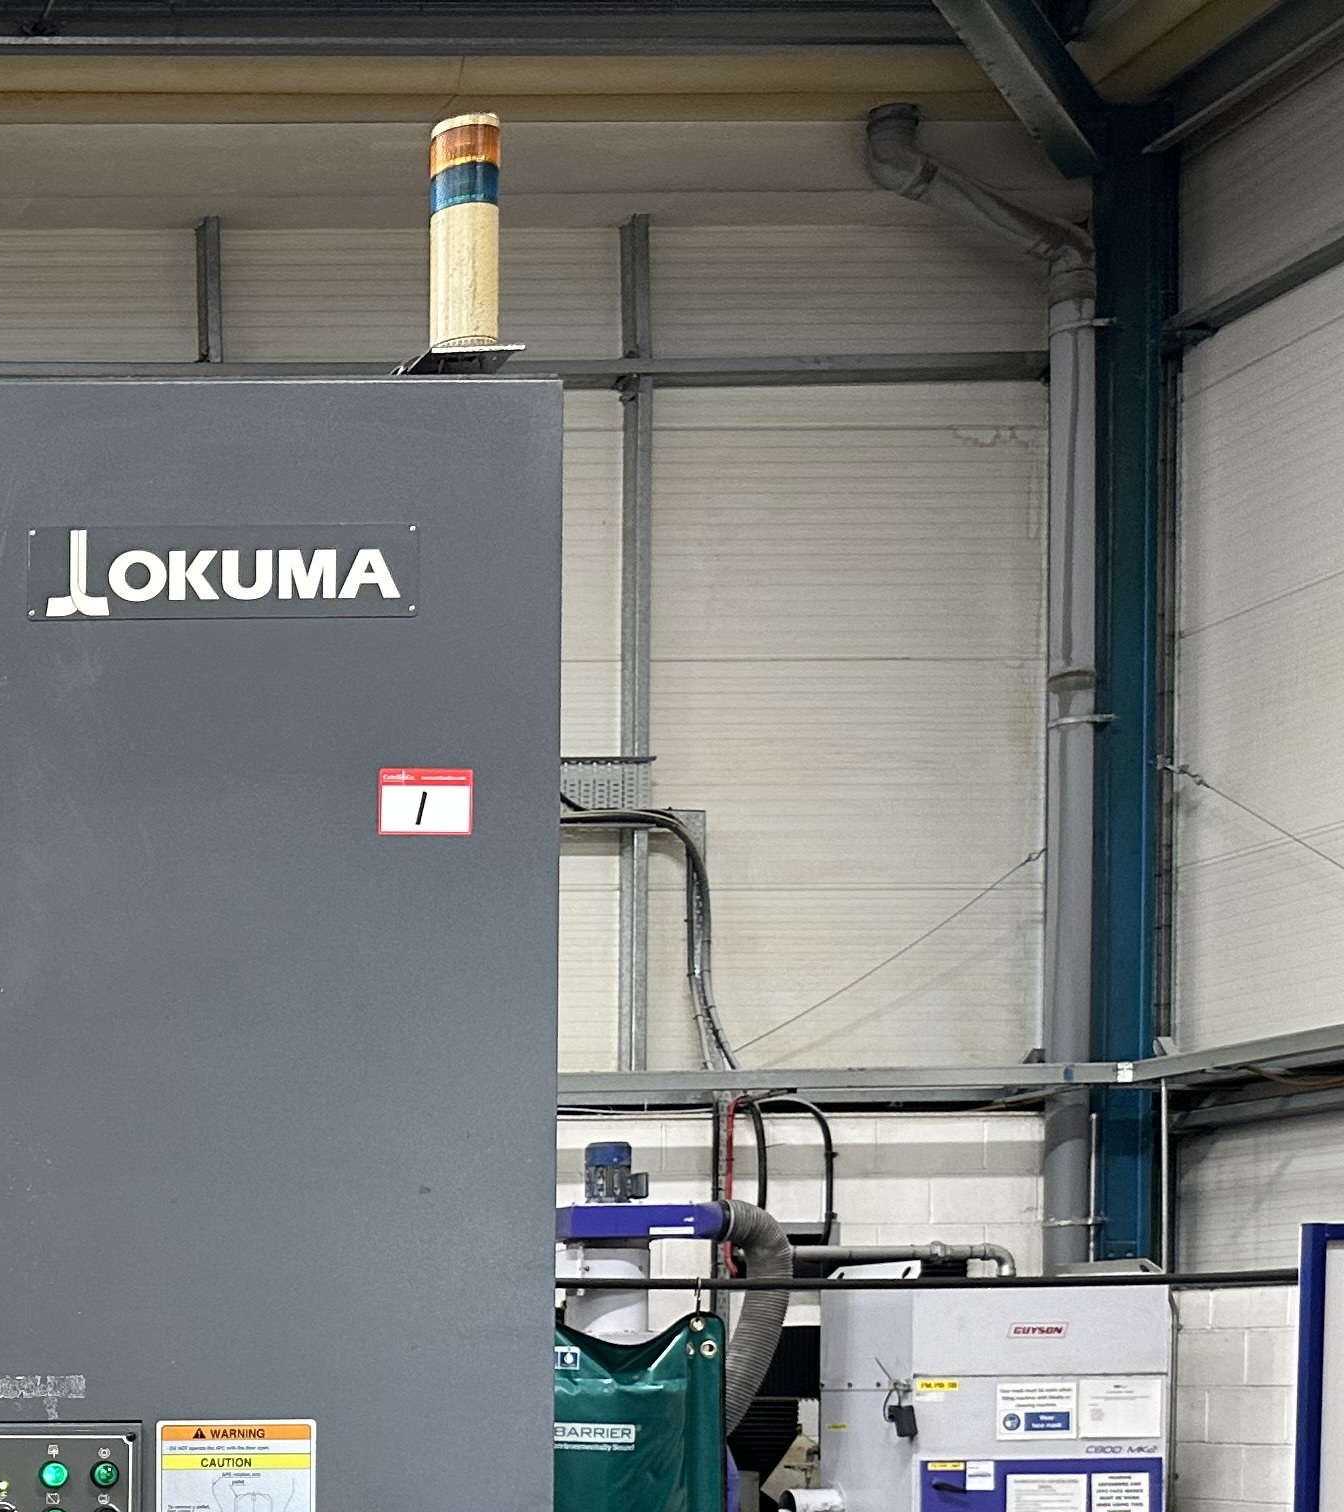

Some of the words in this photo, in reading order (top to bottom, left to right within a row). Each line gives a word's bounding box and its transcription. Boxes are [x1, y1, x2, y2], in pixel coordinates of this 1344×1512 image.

[108, 548, 401, 602] OKUMA
[1013, 1326, 1063, 1335] GUYSON
[210, 1428, 266, 1439] WARNING
[554, 1426, 631, 1439] BARRIER
[200, 1457, 252, 1468] CAUTION
